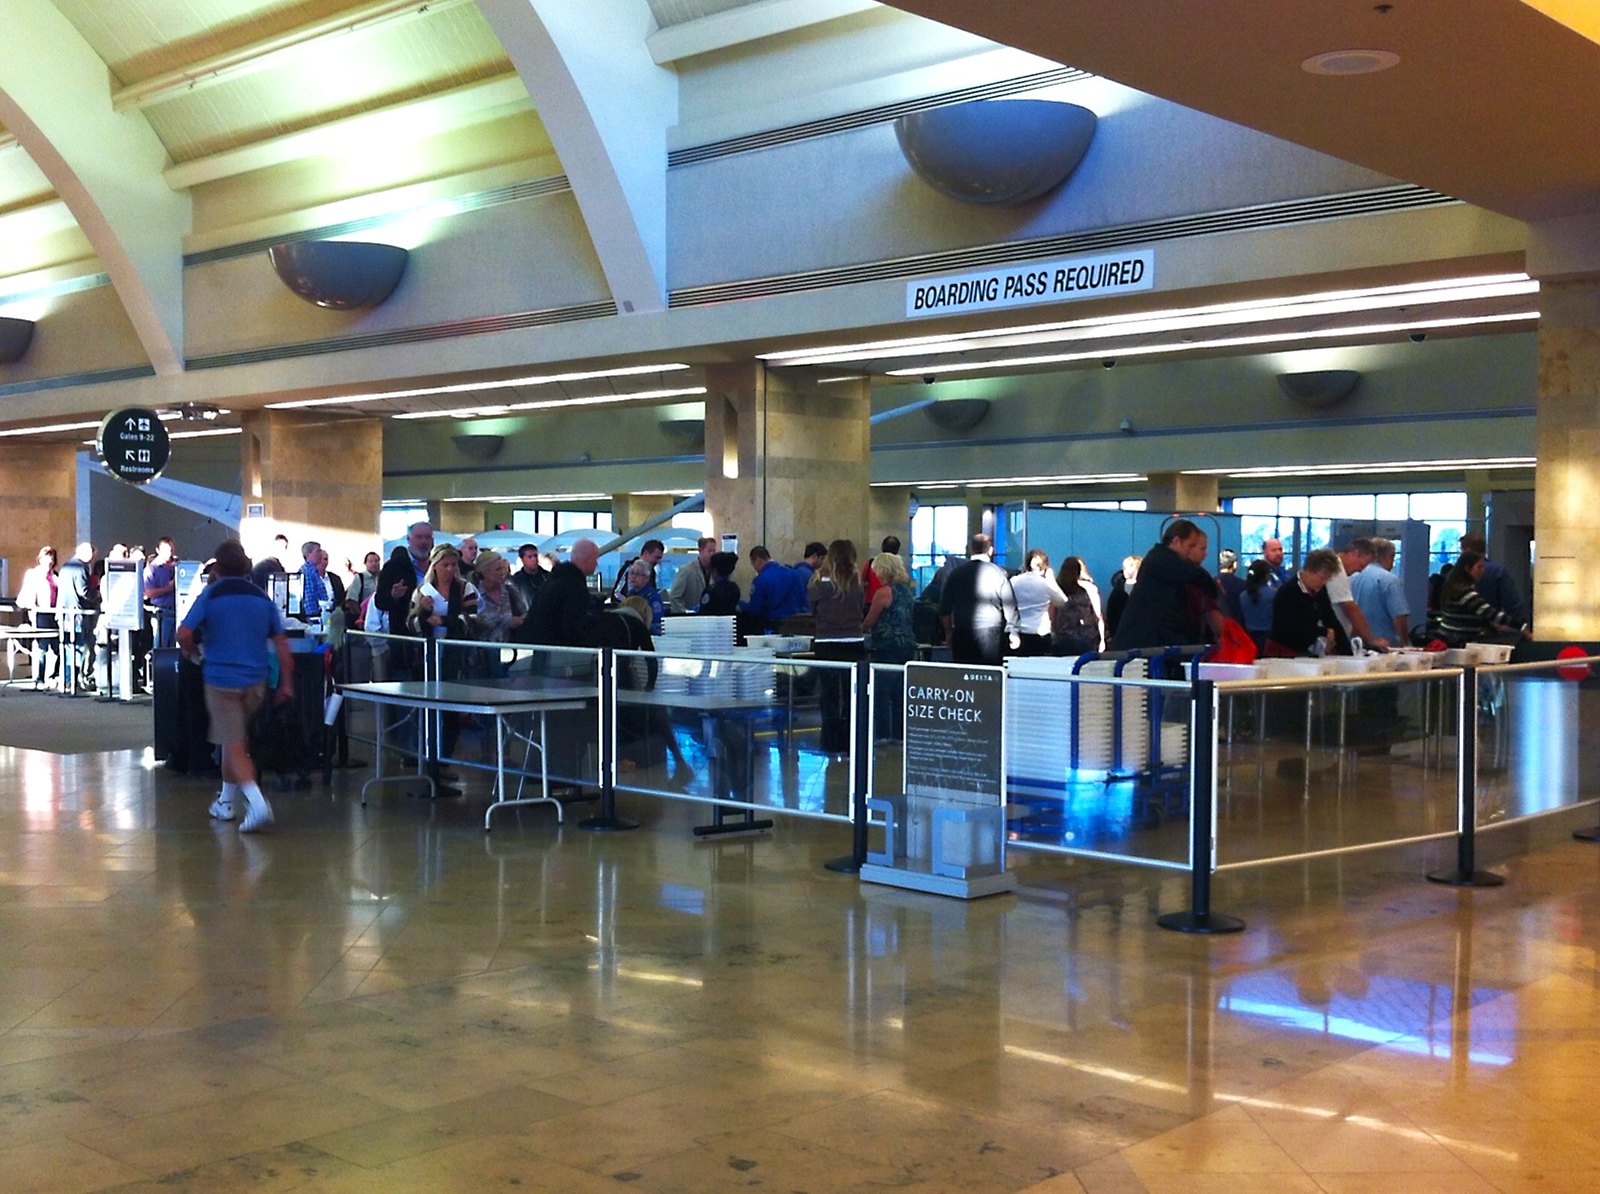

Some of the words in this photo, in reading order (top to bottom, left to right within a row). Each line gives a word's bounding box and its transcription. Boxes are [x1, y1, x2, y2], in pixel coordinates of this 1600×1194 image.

[914, 277, 999, 310] BOARDING
[1003, 271, 1048, 299] PASS
[1053, 259, 1144, 294] REQUIRED
[120, 432, 138, 440] Gates
[139, 434, 155, 442] 9-22
[120, 465, 154, 473] Restrooms
[908, 686, 975, 703] CARRY-ON
[908, 704, 934, 719] SIZE
[938, 706, 982, 723] CHECK
